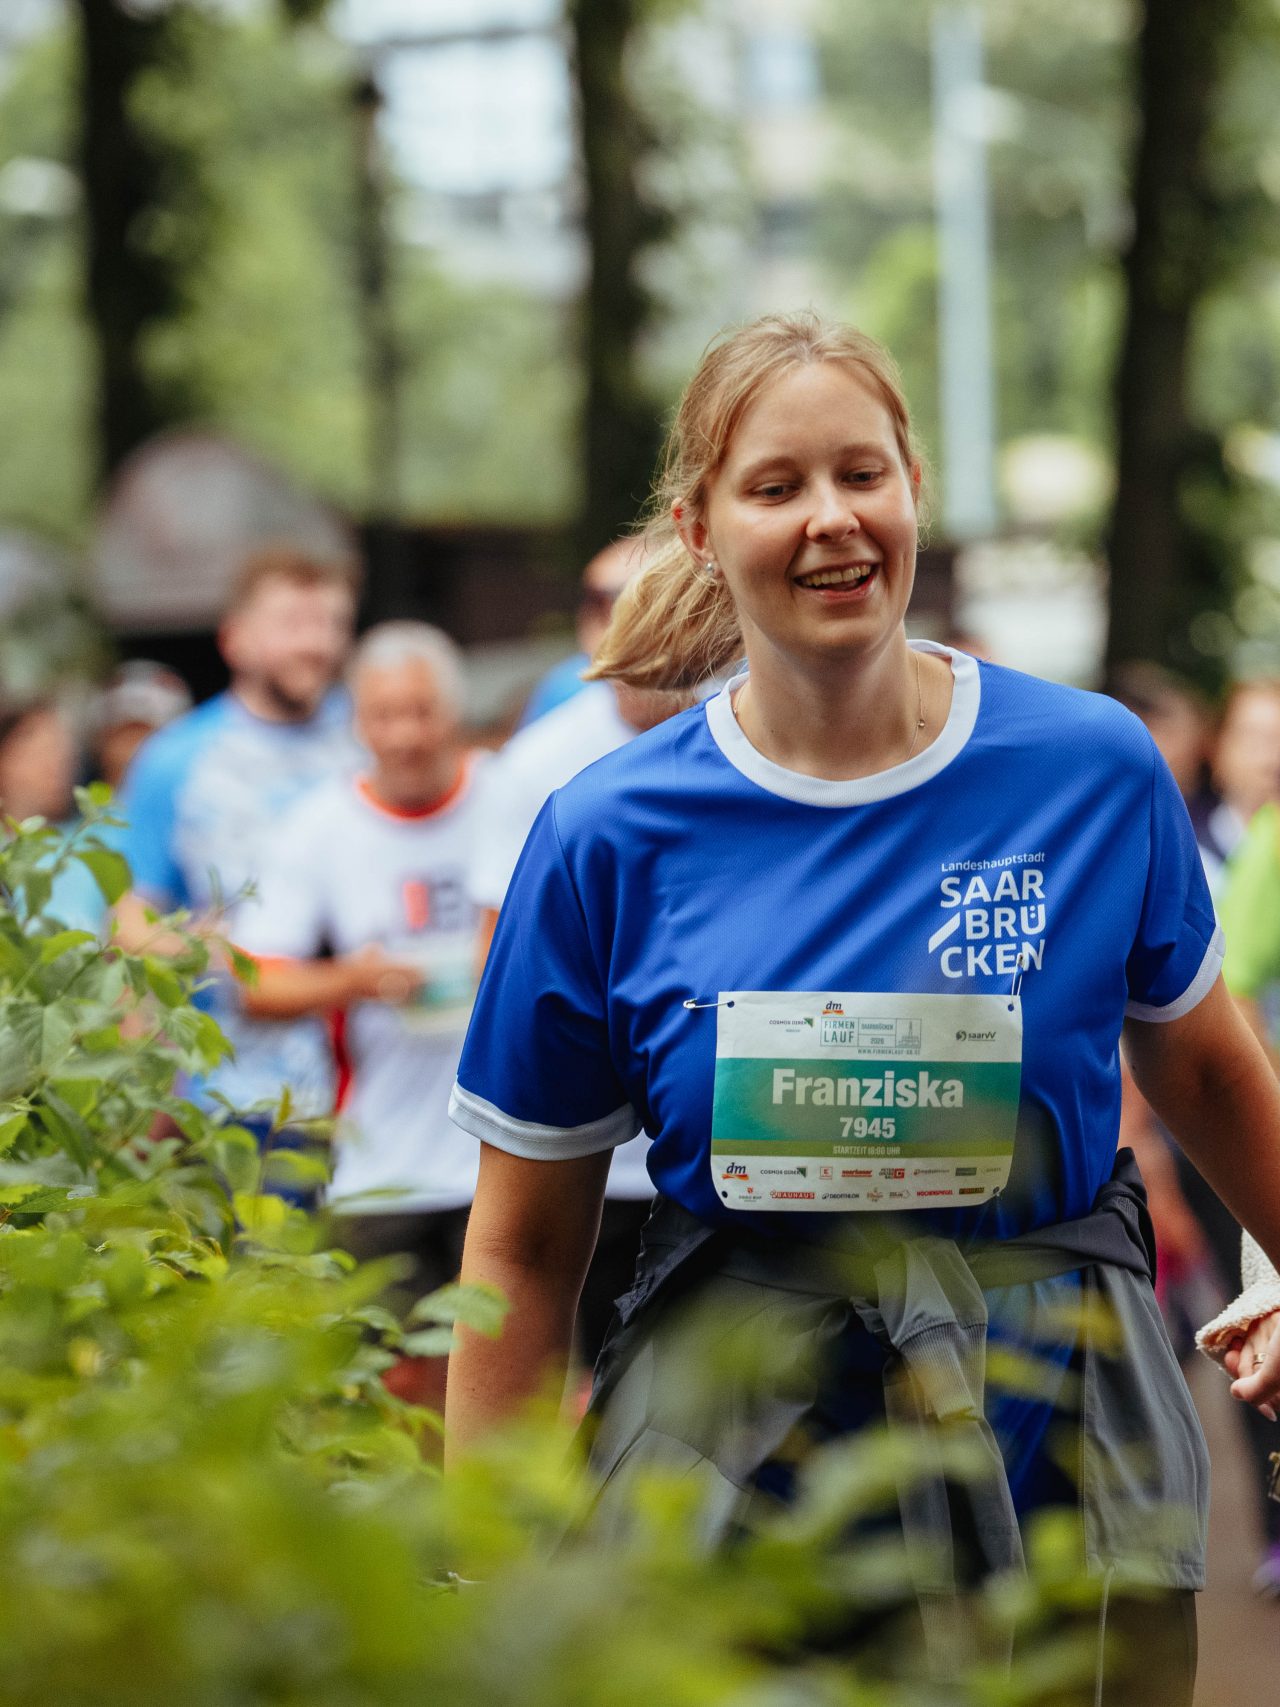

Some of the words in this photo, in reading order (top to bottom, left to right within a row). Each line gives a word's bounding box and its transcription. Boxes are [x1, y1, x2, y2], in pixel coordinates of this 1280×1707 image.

[941, 852, 1046, 872] Landeshauptstadt
[940, 869, 1046, 908] SAAR
[940, 939, 1046, 979] CKEN
[824, 1020, 855, 1030] FIRMEN
[824, 1031, 854, 1043] LAUF
[772, 1068, 964, 1108] Franziska
[840, 1117, 896, 1138] 7945
